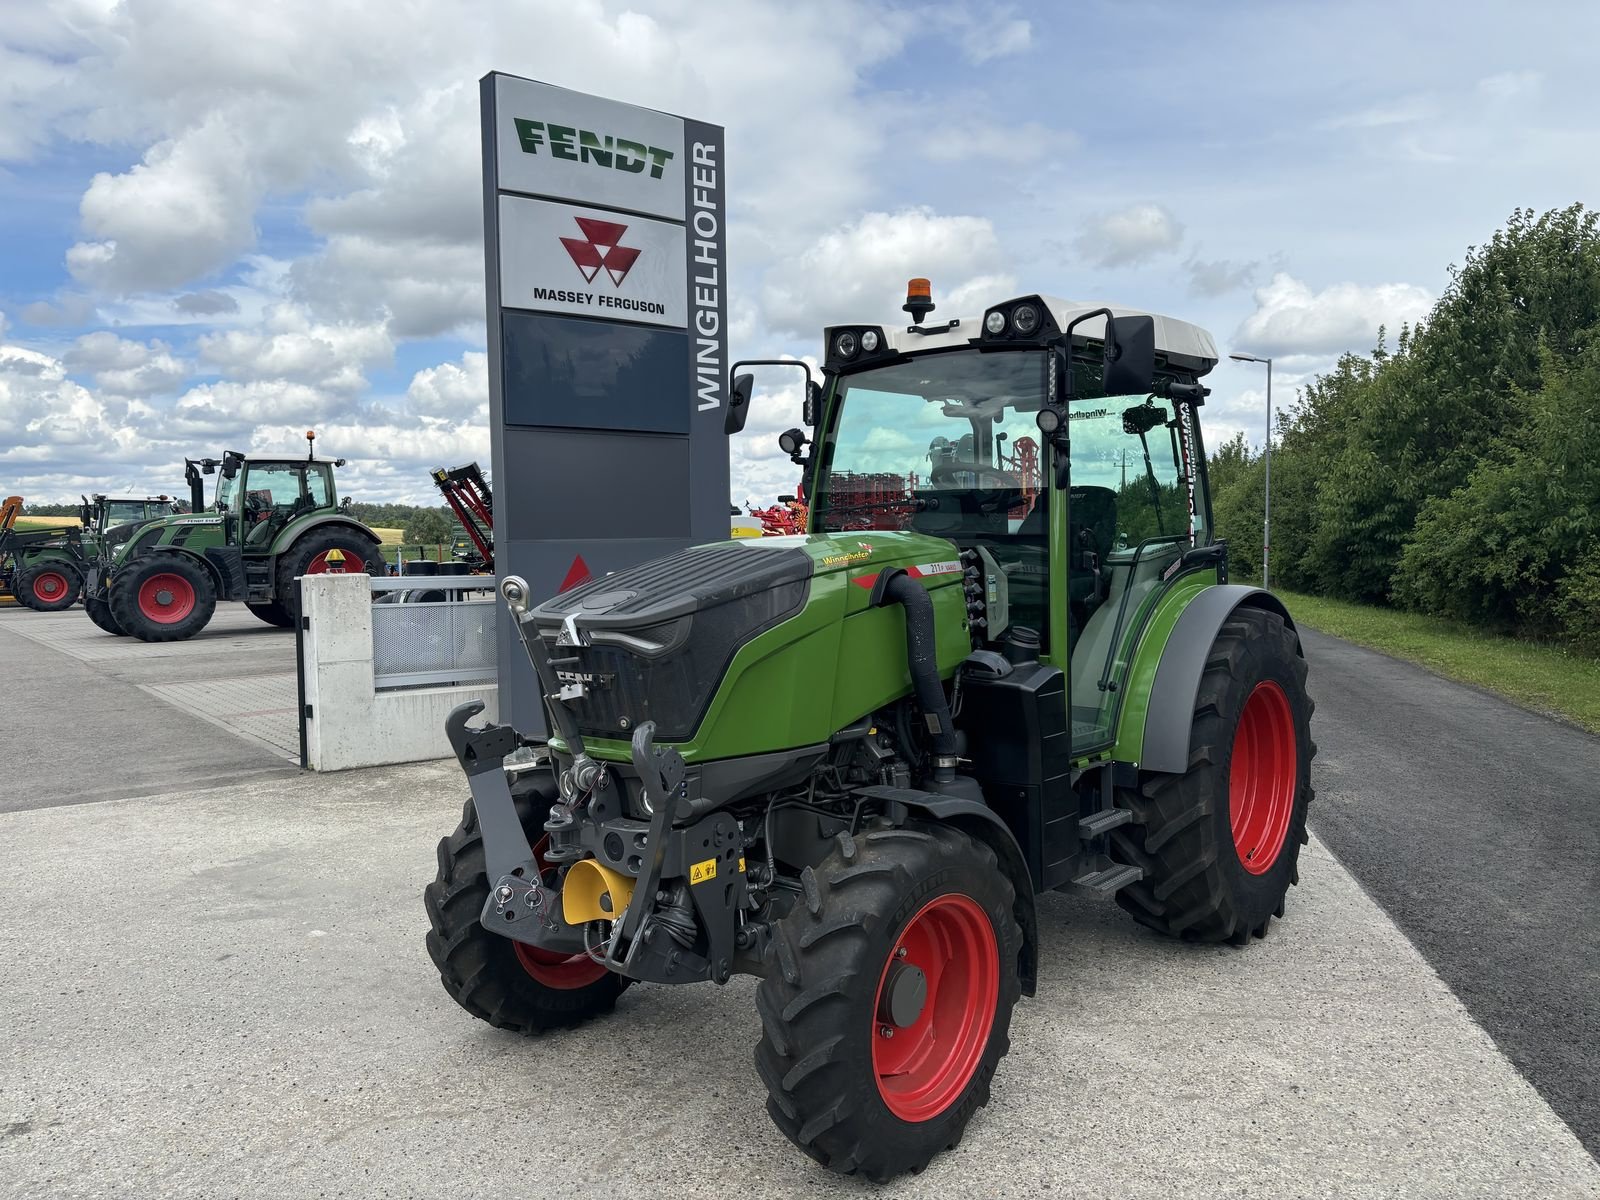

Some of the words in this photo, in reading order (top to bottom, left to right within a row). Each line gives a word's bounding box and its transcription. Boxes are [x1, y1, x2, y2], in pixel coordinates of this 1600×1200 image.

[513, 117, 674, 179] FENDT
[533, 287, 594, 305] MASSEY
[598, 295, 665, 315] FERGUSON
[693, 141, 720, 412] WINGELHOFER
